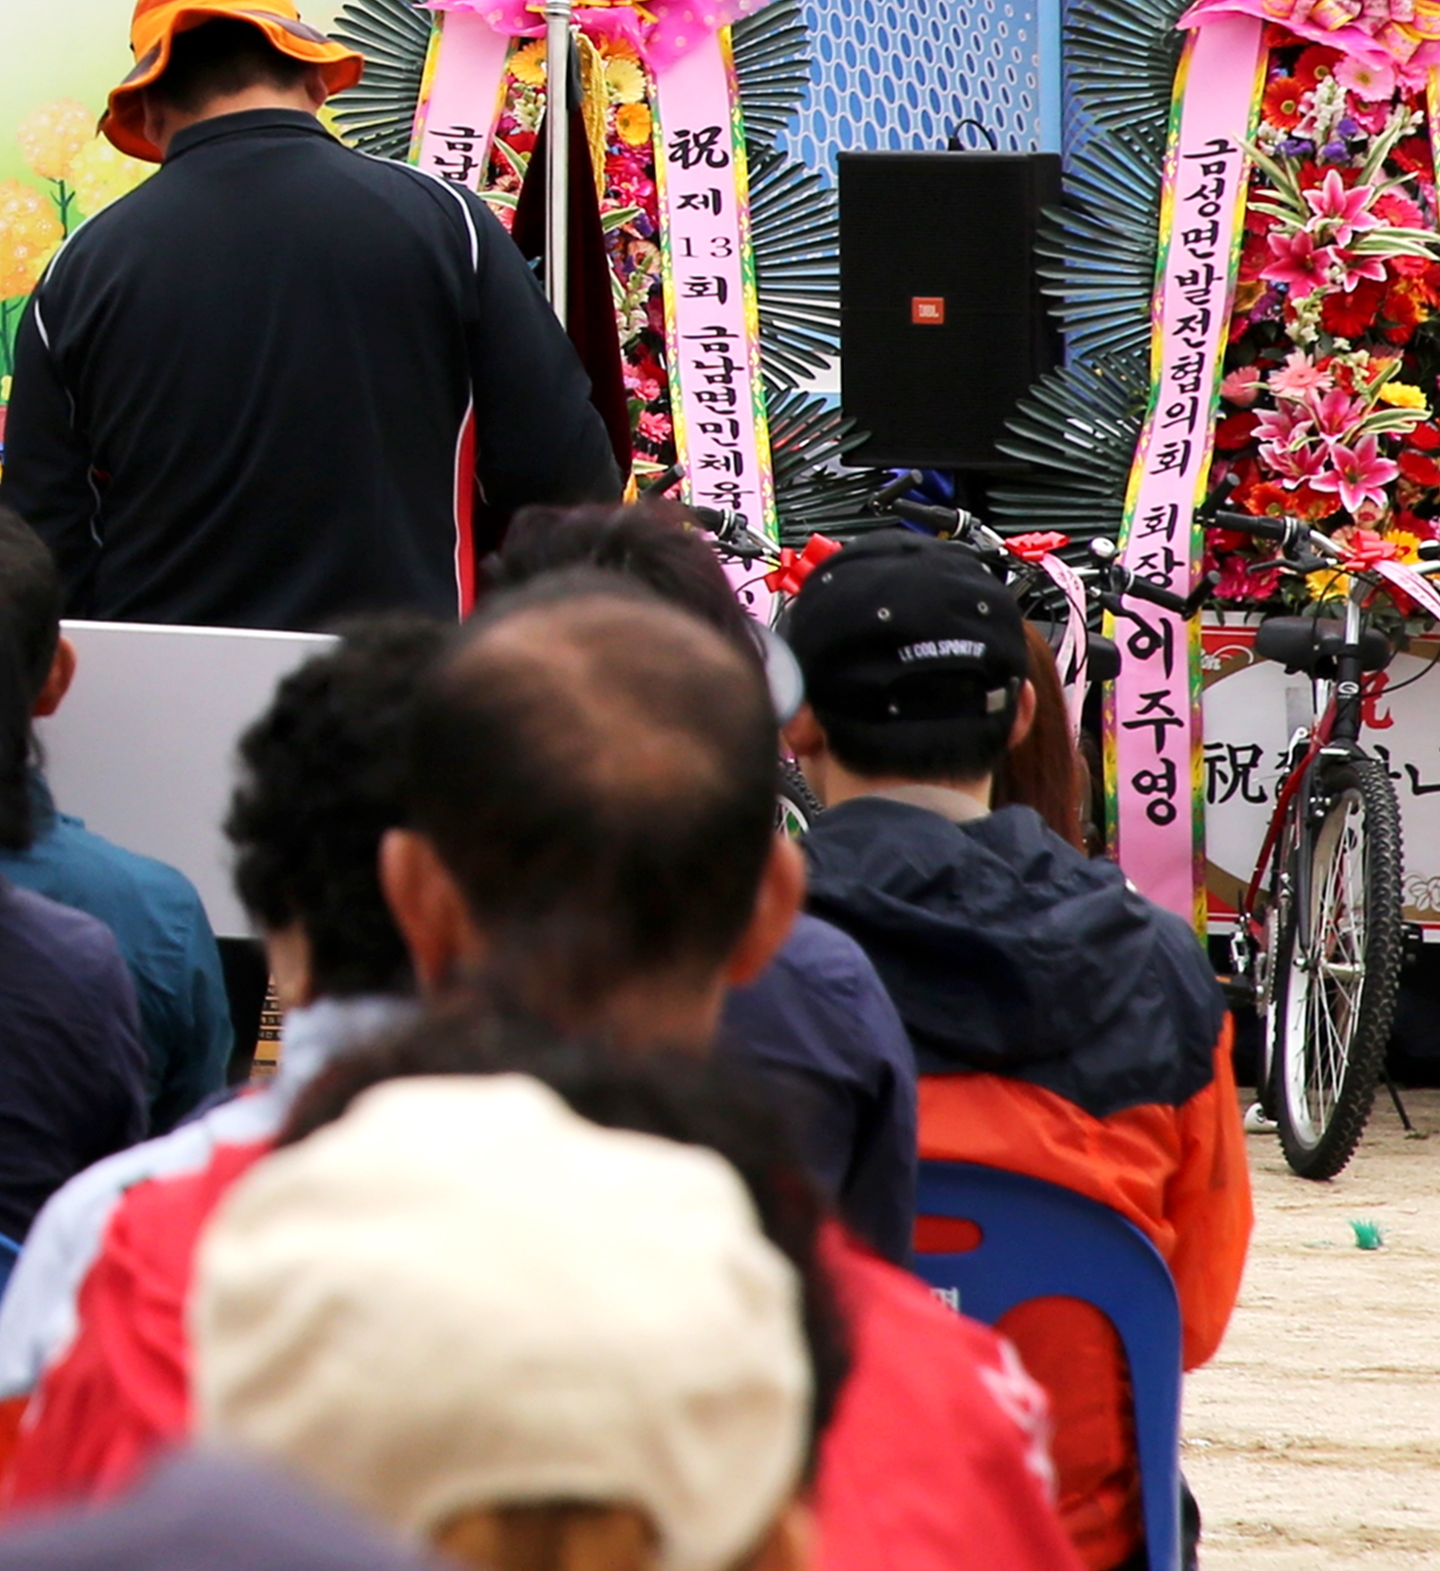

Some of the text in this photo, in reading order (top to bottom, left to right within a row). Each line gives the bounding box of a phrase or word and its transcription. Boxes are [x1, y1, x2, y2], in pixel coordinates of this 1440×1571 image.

[667, 125, 729, 170] 祝
[1148, 137, 1238, 479] 금성면발전협의회
[897, 638, 987, 663] LE COQ SPORTIF
